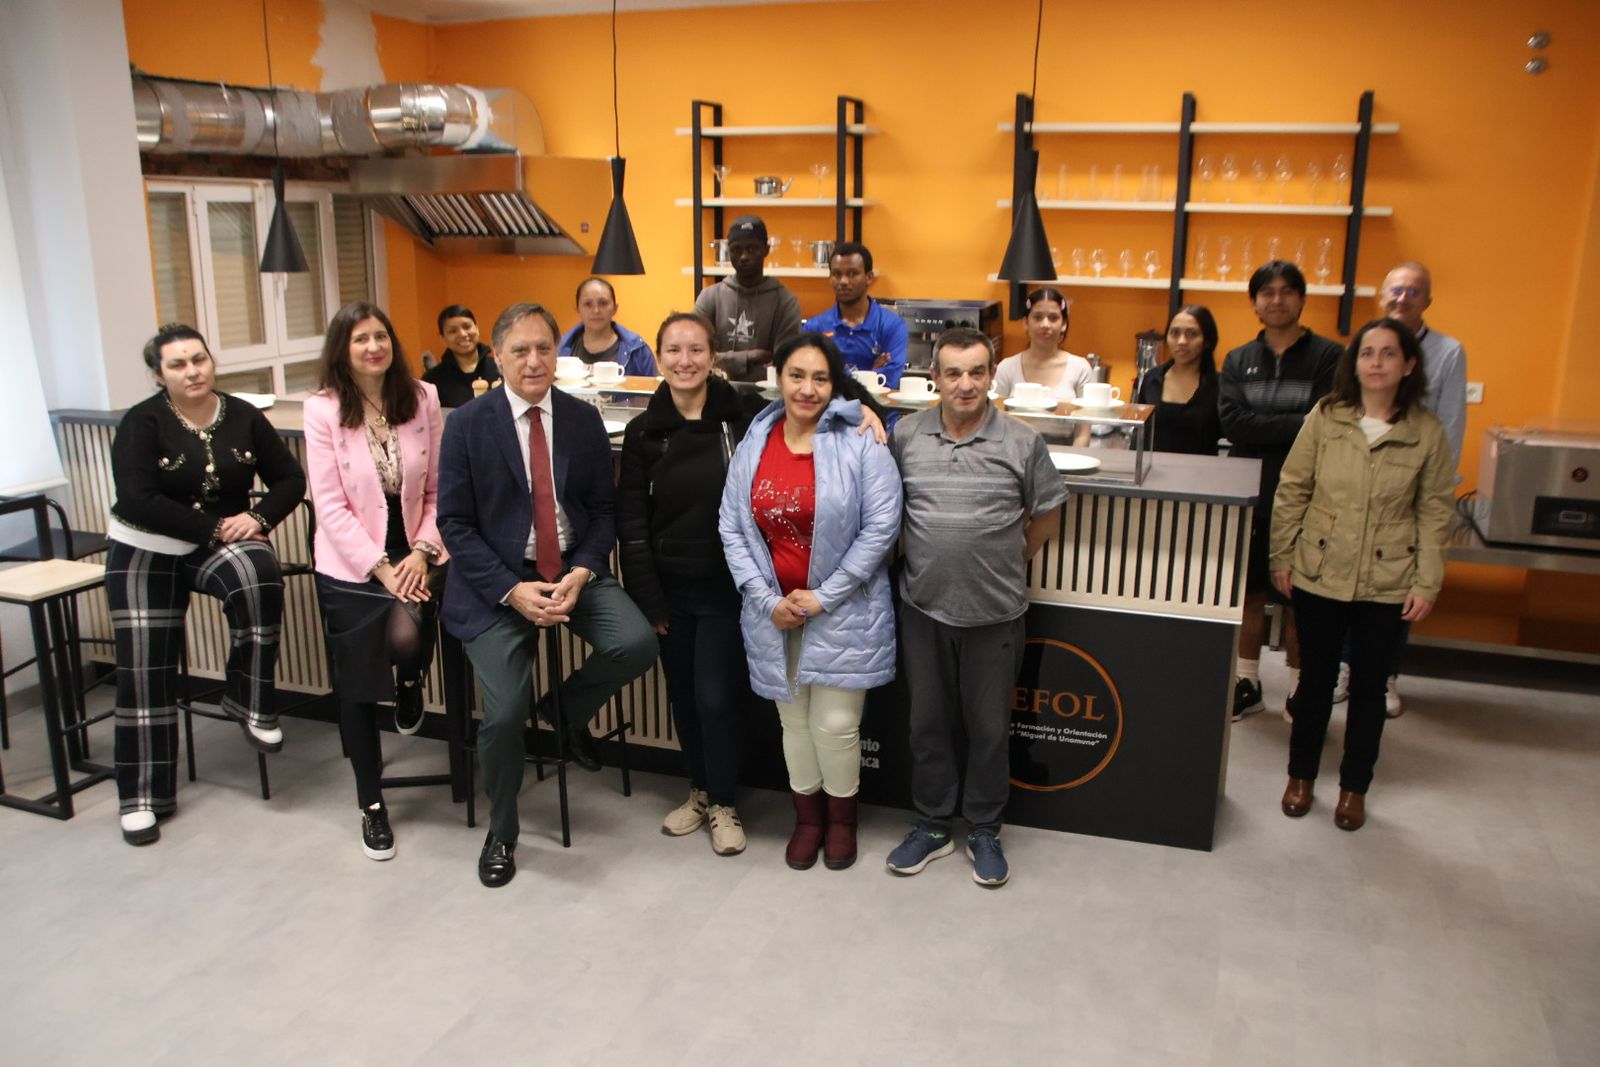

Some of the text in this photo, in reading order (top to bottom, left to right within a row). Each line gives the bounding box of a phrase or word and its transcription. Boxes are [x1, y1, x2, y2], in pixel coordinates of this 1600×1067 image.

[1010, 687, 1104, 720] EFOL
[1016, 722, 1055, 733] Formación
[1063, 728, 1107, 739] Orientación
[1047, 733, 1057, 741] de
